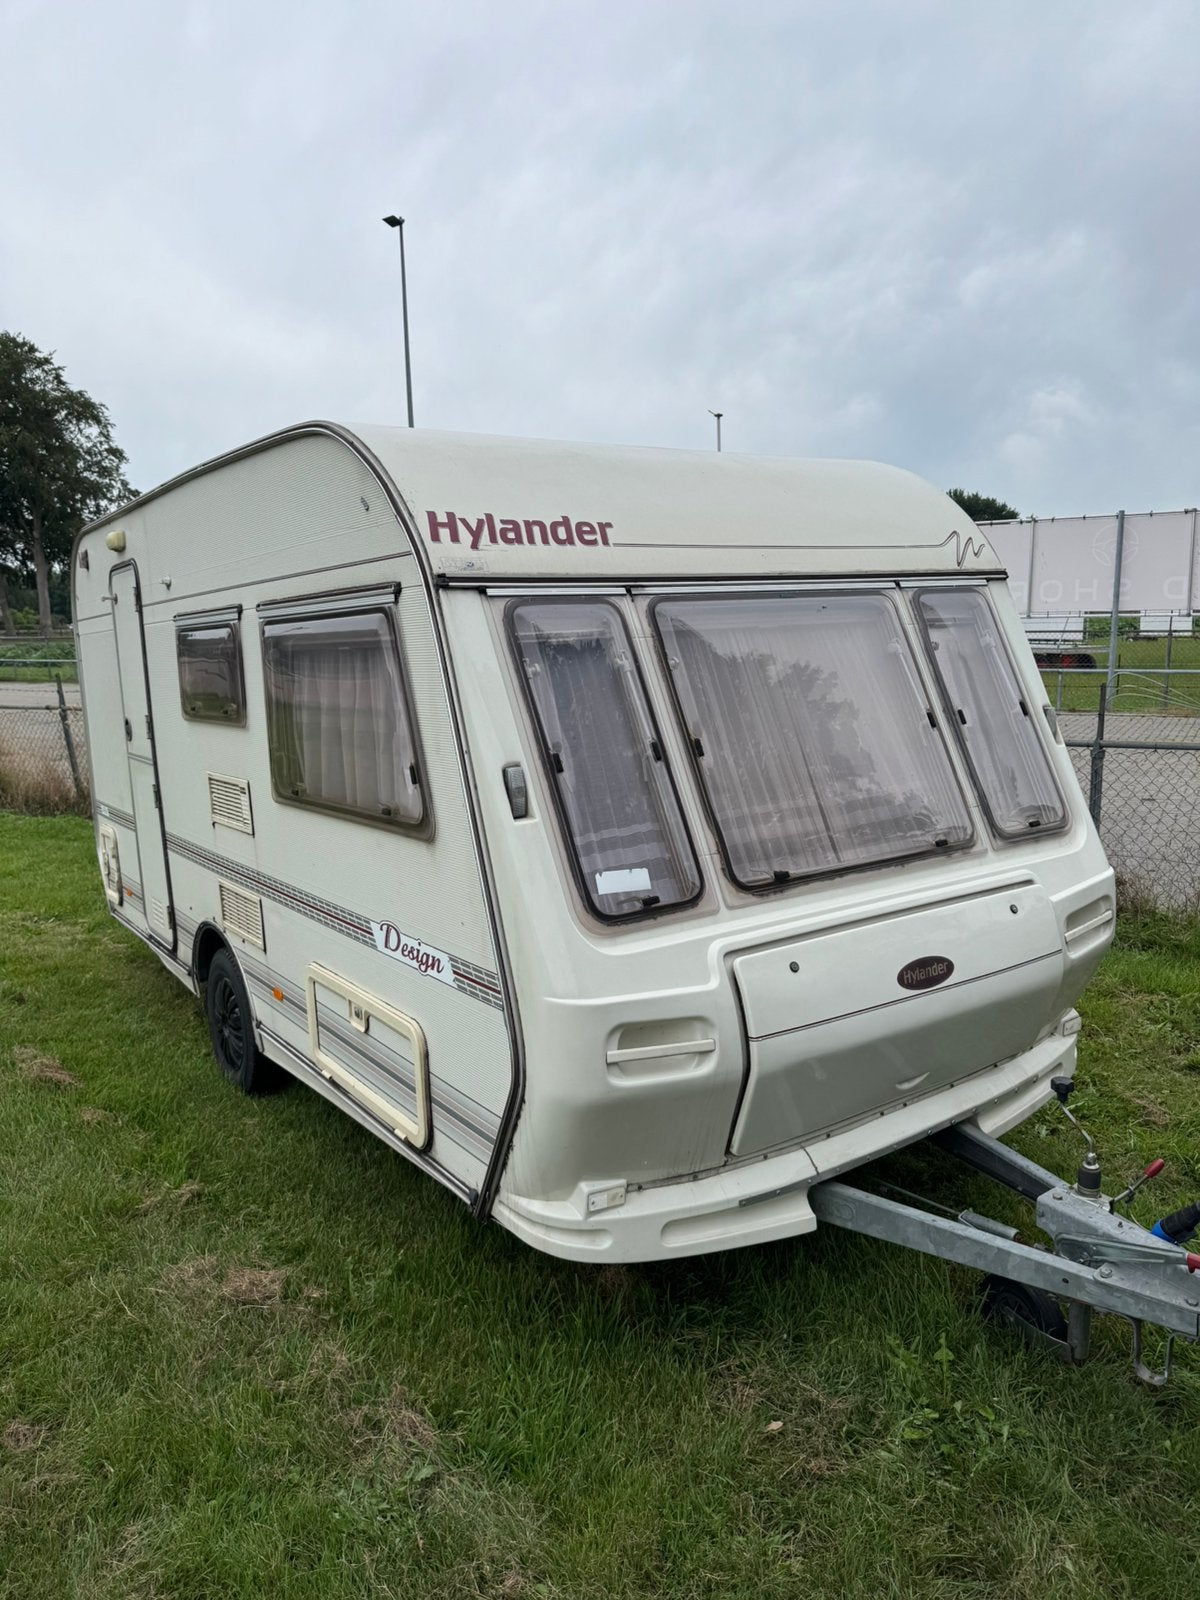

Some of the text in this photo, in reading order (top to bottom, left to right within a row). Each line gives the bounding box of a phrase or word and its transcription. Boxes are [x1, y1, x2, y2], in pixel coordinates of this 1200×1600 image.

[426, 511, 613, 550] Hylander
[380, 922, 444, 973] Design
[903, 961, 949, 985] Hylander
